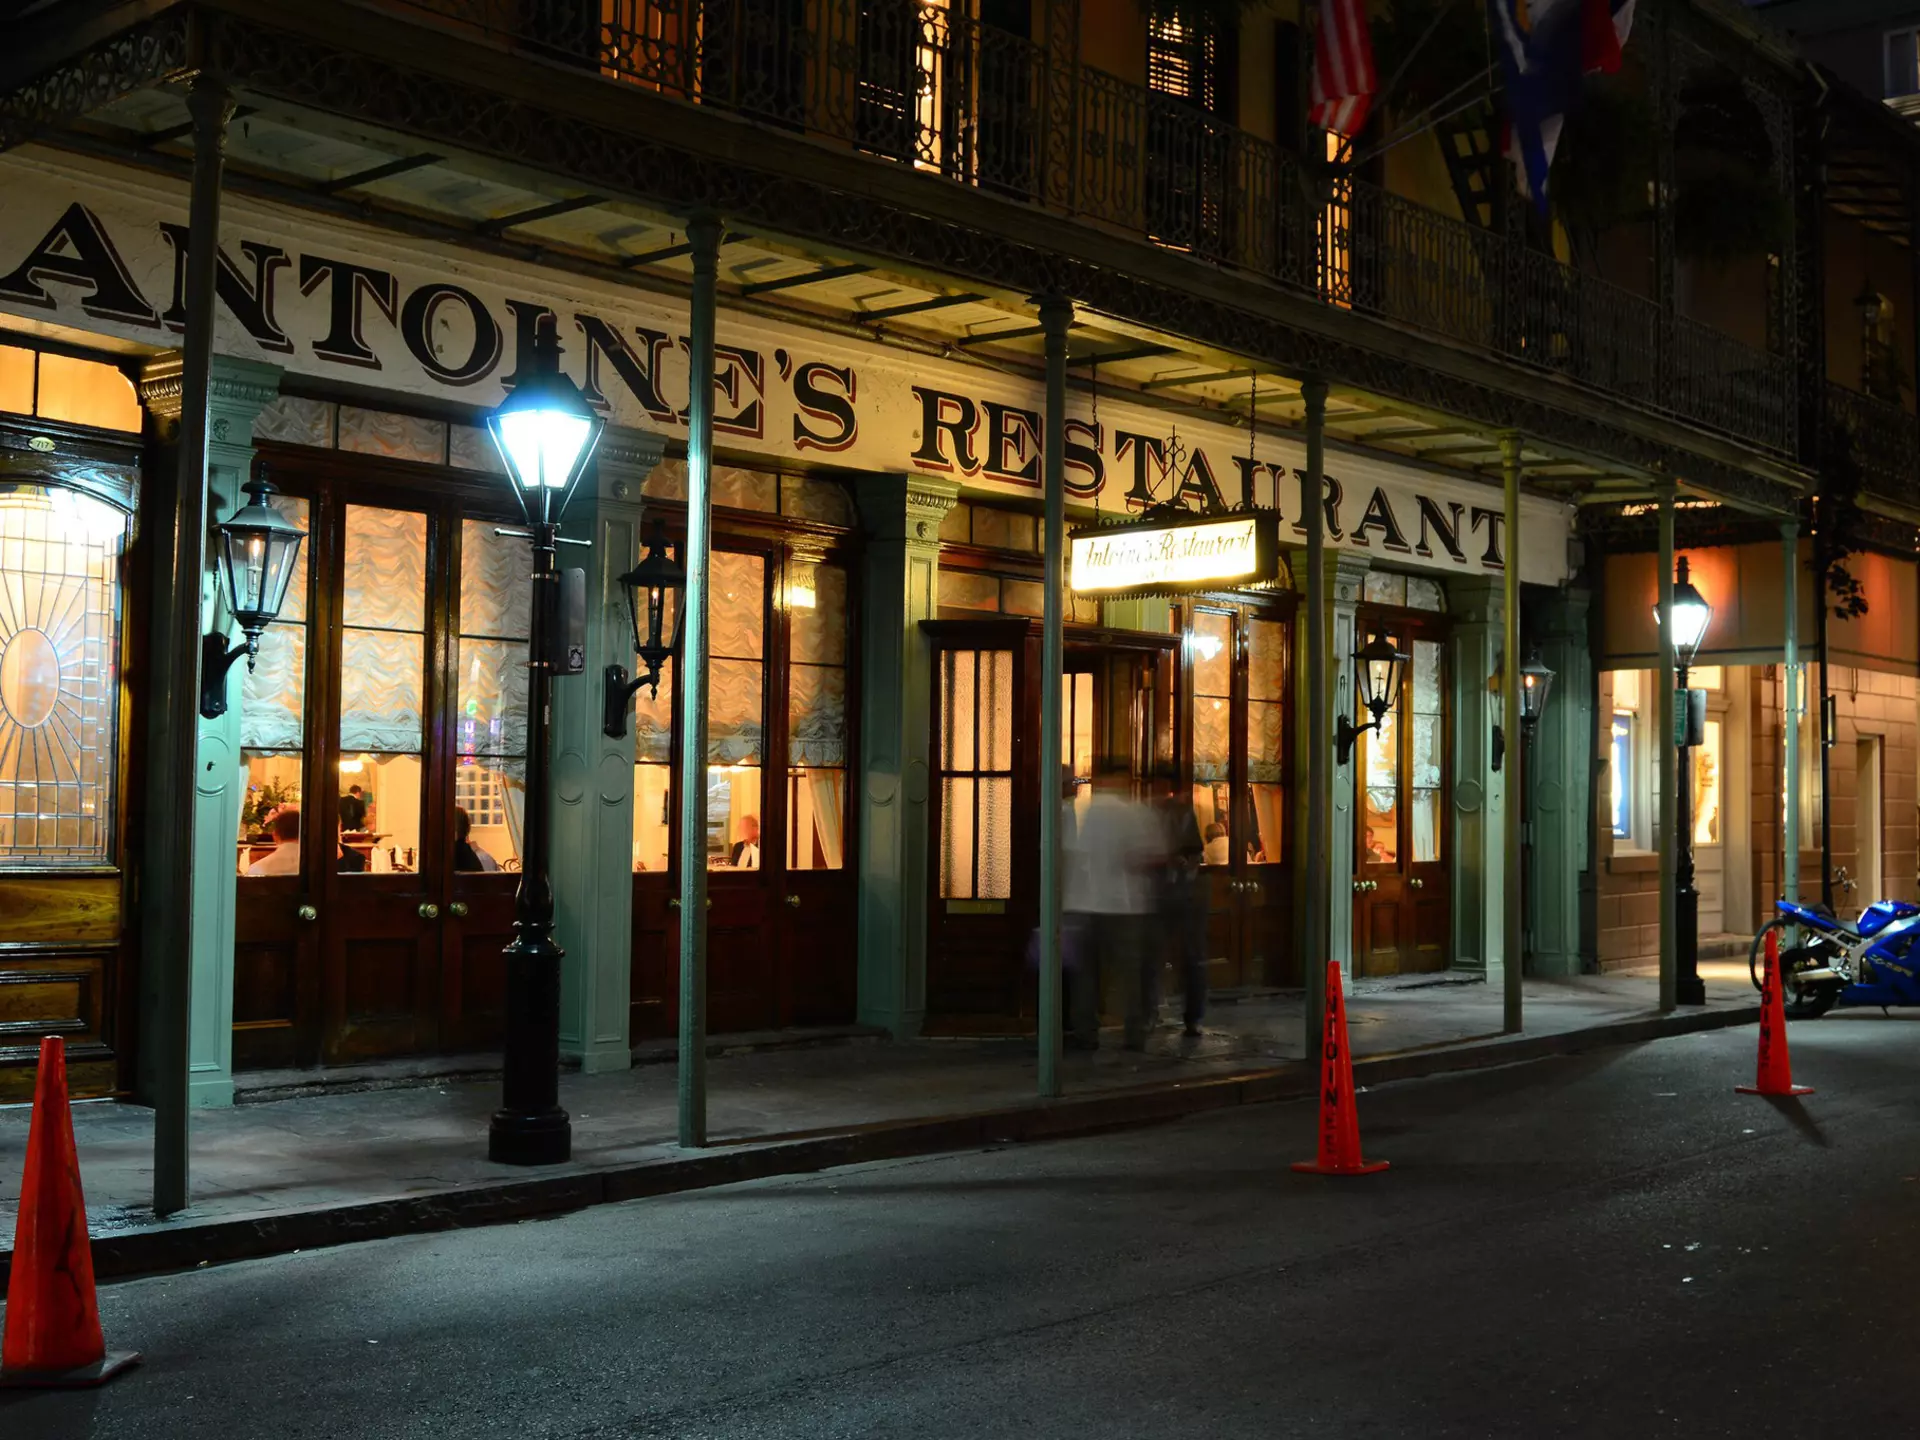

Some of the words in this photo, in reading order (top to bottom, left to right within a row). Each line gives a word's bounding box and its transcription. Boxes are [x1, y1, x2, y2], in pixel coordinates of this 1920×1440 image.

[0, 202, 859, 453] ANTOINE'S
[911, 385, 1505, 570] RESTAURANT
[36, 440, 50, 449] 717
